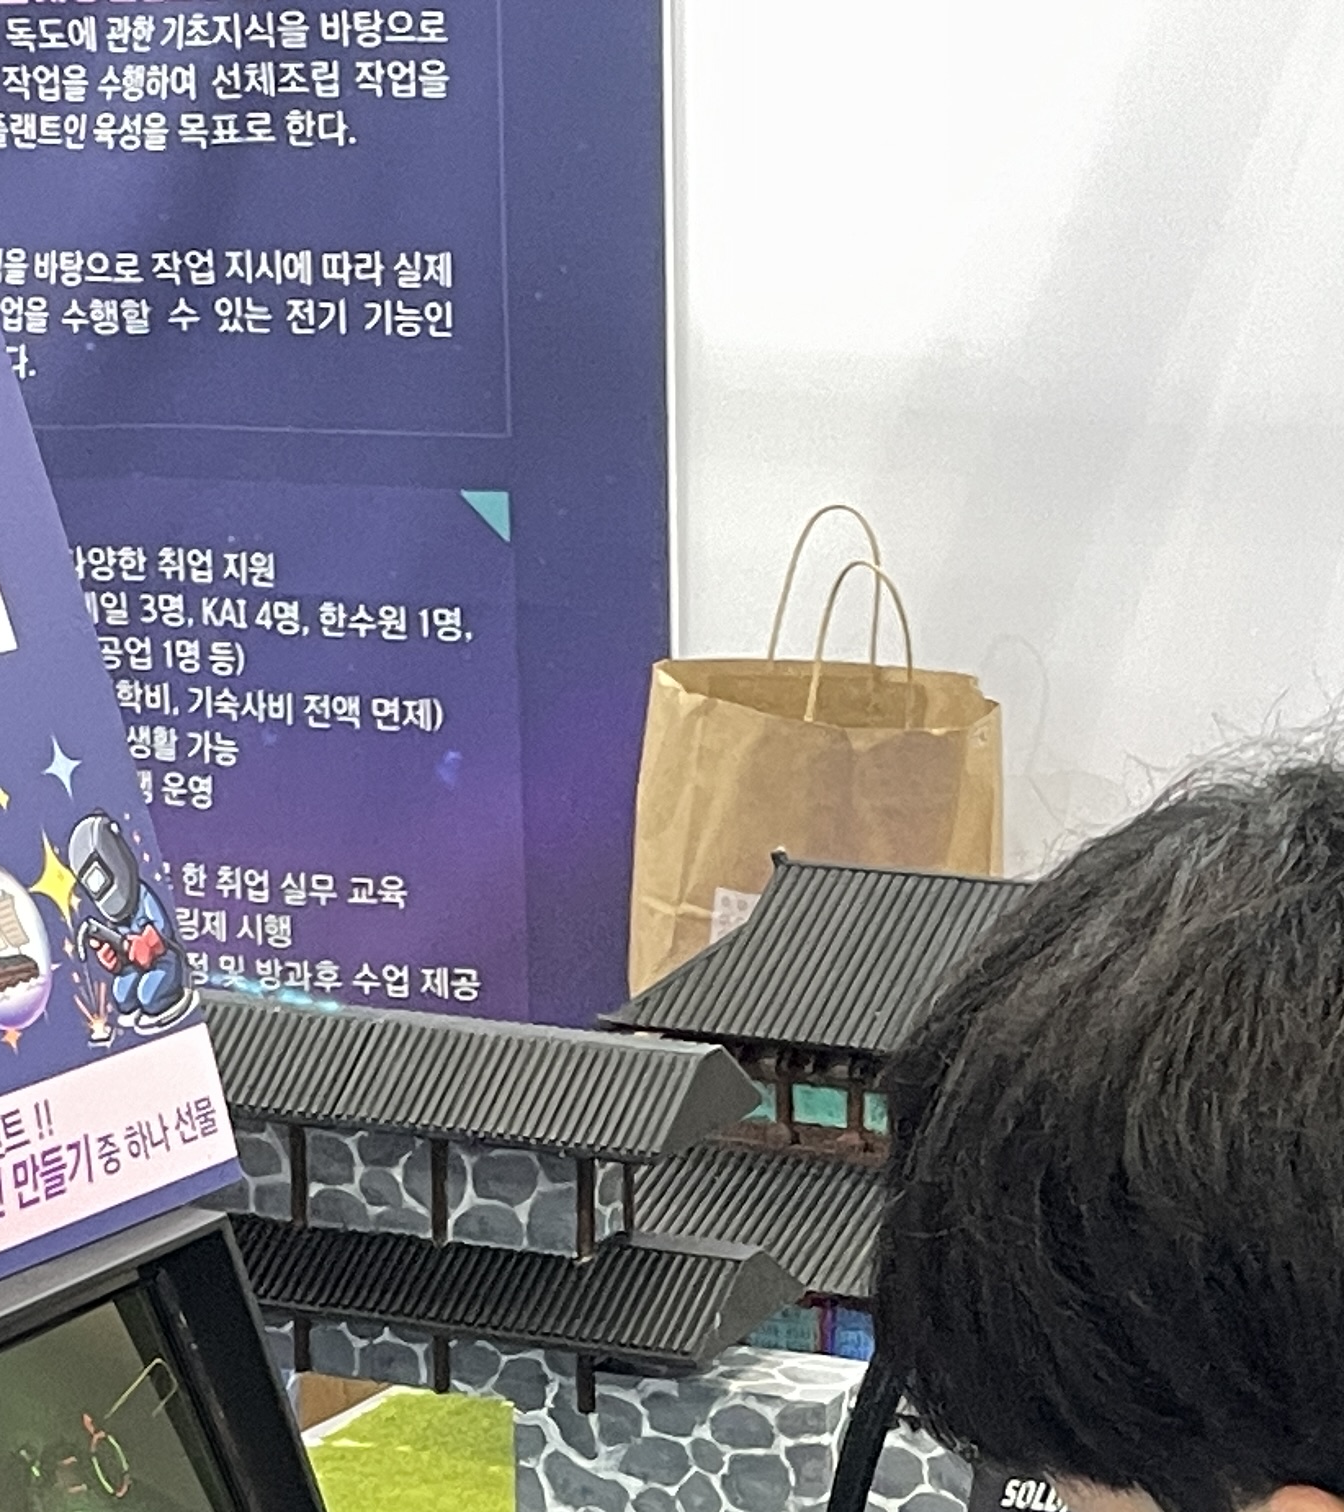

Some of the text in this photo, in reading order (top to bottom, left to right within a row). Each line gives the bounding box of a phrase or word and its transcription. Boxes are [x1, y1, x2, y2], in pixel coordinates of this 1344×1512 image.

[6, 15, 98, 53] 독도에
[106, 14, 155, 52] 관한
[160, 10, 310, 50] 기초지식을
[320, 9, 450, 48] 바탕으로
[2, 64, 89, 102] 작업을
[97, 63, 197, 102] 수행하여
[212, 60, 341, 99] 선체조립
[355, 59, 450, 99] 작업을
[93, 111, 170, 151] 육성을
[178, 111, 276, 150] 목표로
[285, 109, 357, 147] 한다.
[34, 248, 144, 287] 바탕으로
[151, 248, 216, 286] 작업
[224, 248, 313, 287] 지시에
[321, 250, 385, 288] 따라
[393, 250, 453, 289] 실제
[61, 297, 152, 335] 수행할
[167, 296, 201, 332] 수
[214, 296, 273, 334] 있는
[285, 297, 348, 336] 전기
[363, 298, 453, 338] 기능인
[158, 547, 214, 584] 취업
[222, 551, 275, 588] 지원
[139, 593, 194, 628] 3명,
[202, 596, 248, 630] KAI
[255, 600, 310, 638] 4명,
[318, 601, 408, 640] 한수원
[418, 607, 473, 643] 1명,
[97, 636, 246, 678] 공업 1명 등)
[187, 685, 295, 727] 기숙사비
[303, 691, 361, 731] 전액
[371, 696, 444, 733] 면제)
[127, 725, 240, 768] 생활 가능
[161, 771, 214, 811] 운영
[215, 865, 270, 903] 취업
[279, 871, 338, 907] 실무
[347, 875, 409, 910] 교육
[236, 914, 294, 949] 시행
[255, 957, 343, 994] 방과후
[352, 962, 410, 998] 수업
[420, 967, 483, 1002] 제공
[12, 1133, 94, 1210] 만들기
[123, 1112, 171, 1162] 하나
[174, 1095, 219, 1145] 선물
